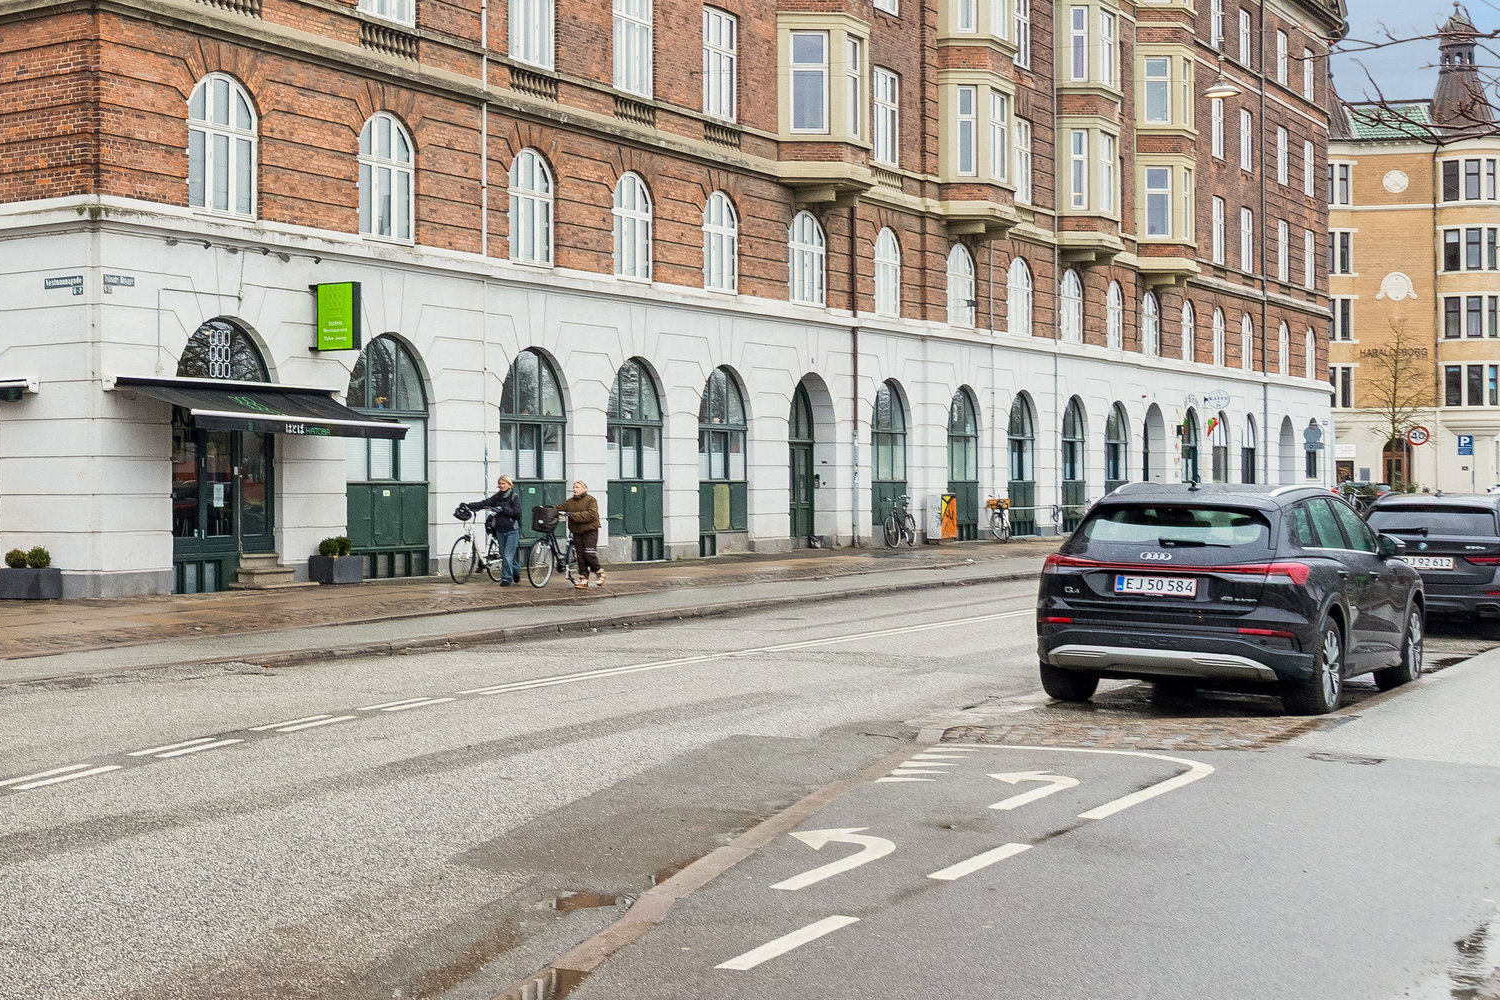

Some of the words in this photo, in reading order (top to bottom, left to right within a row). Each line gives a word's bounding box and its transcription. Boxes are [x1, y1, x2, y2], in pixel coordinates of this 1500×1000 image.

[1411, 431, 1426, 440] 40
[1460, 437, 1470, 447] P
[1418, 558, 1431, 566] 92
[1432, 558, 1451, 567] 612
[1126, 578, 1144, 590] EJ
[1147, 579, 1164, 591] 50
[1169, 580, 1193, 592] 584
[1064, 586, 1080, 594] Q4
